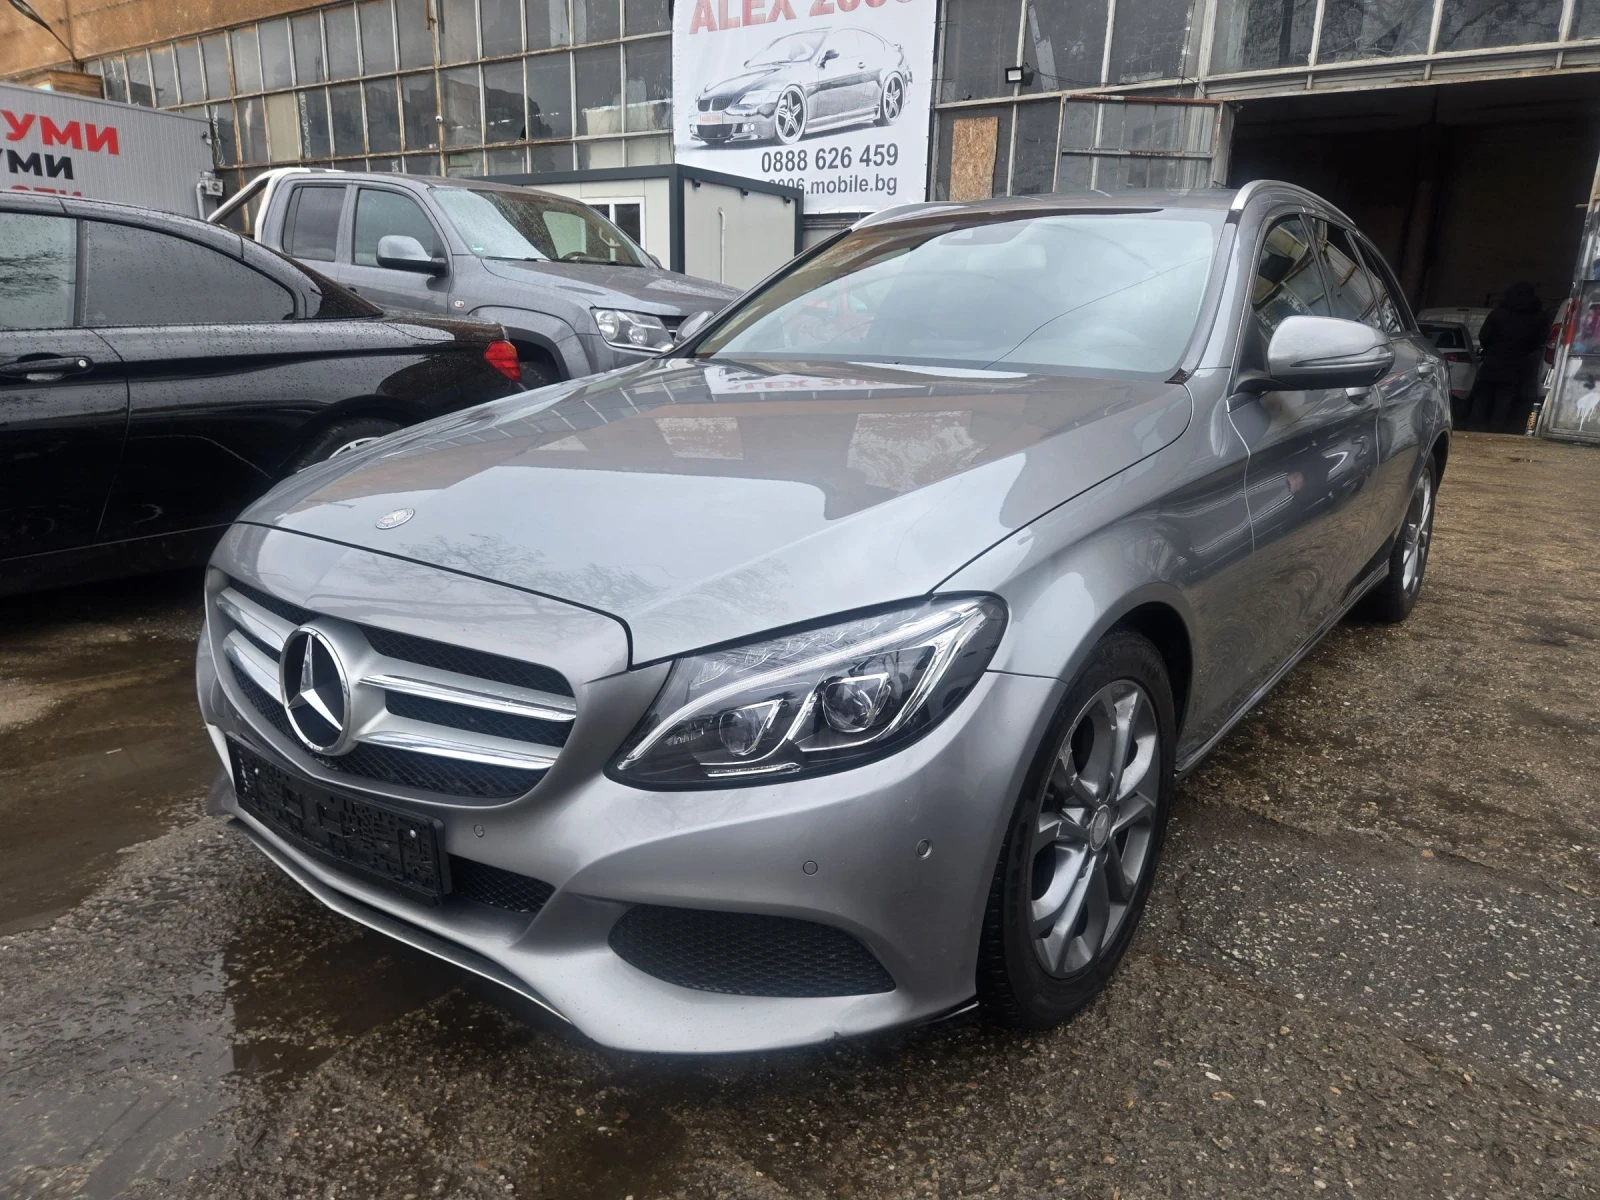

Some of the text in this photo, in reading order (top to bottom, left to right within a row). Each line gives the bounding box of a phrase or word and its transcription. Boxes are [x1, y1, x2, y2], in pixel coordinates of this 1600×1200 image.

[0, 148, 74, 180] МИ
[761, 143, 899, 173] 0888 626 459
